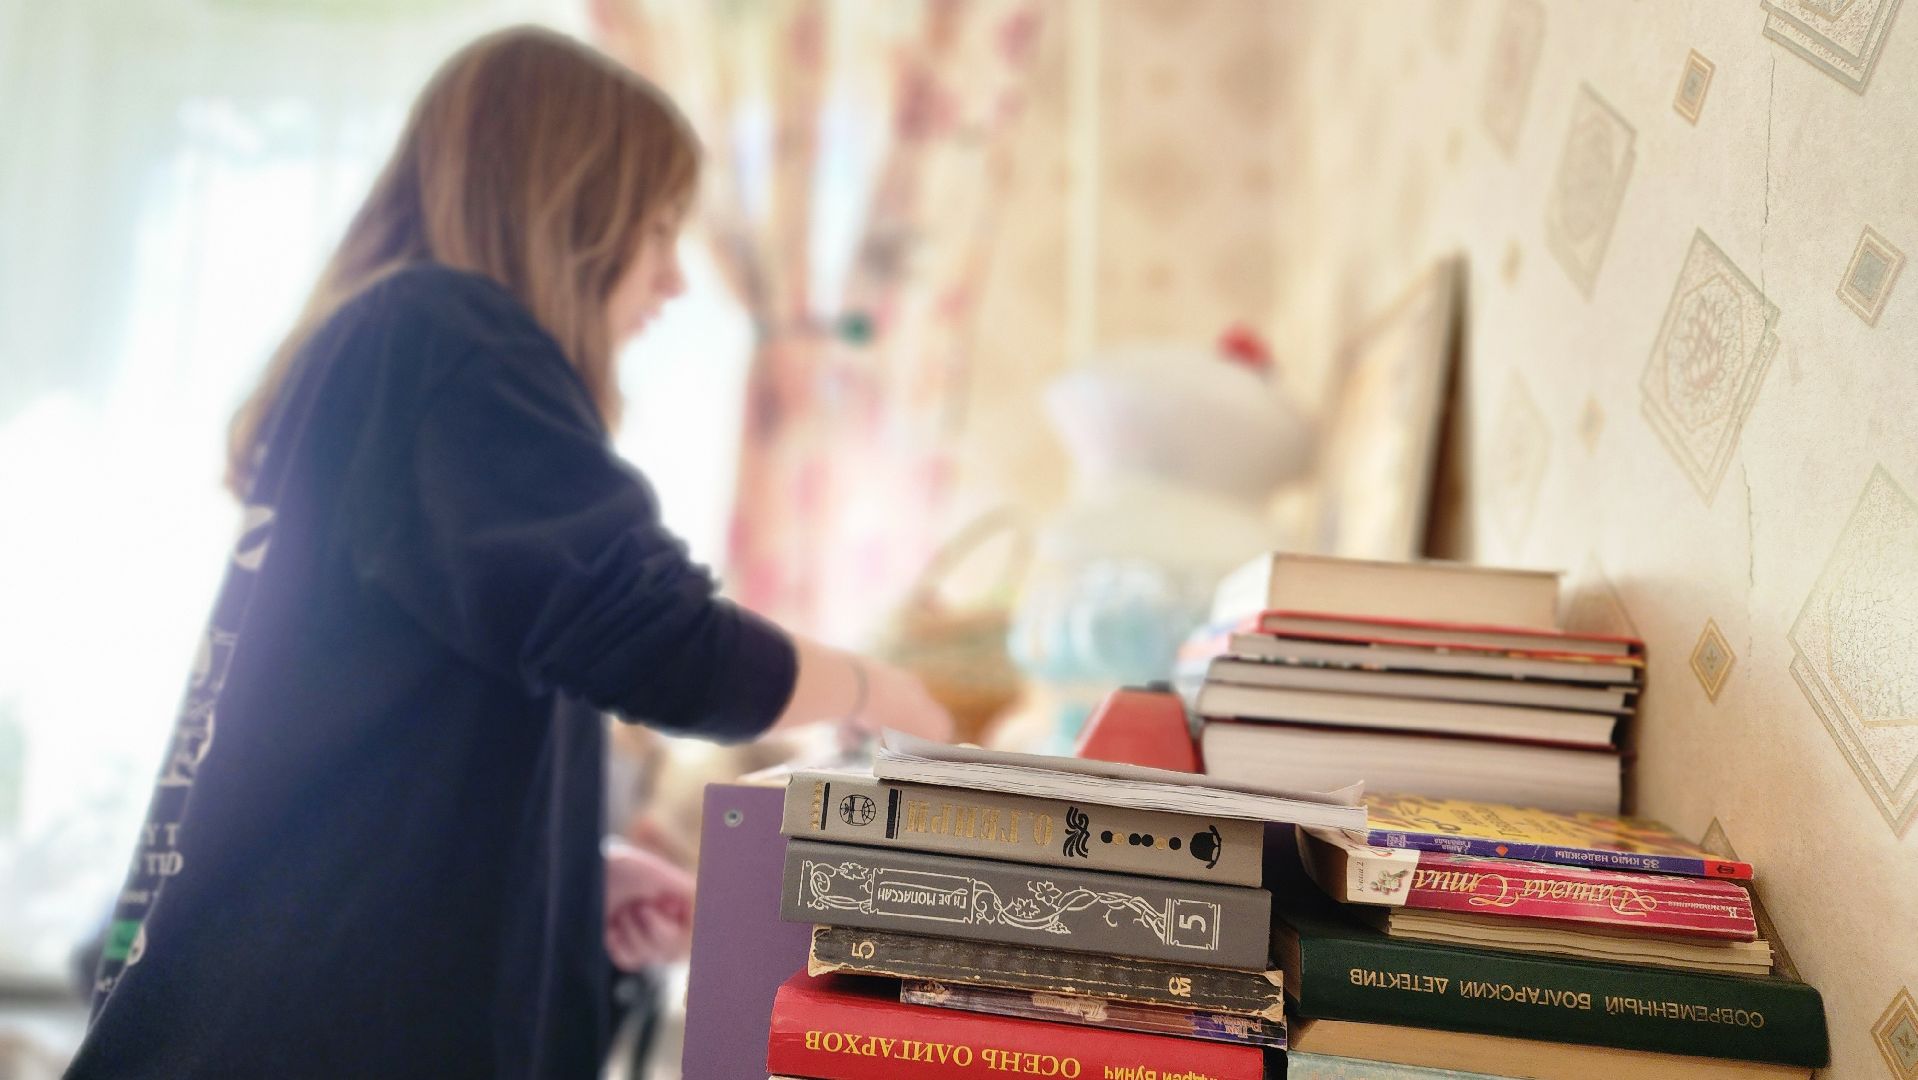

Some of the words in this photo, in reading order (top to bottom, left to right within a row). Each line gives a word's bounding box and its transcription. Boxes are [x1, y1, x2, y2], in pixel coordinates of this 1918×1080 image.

[905, 800, 1022, 844] ГЕНРИ
[1555, 850, 1609, 863] надежды
[1643, 858, 1660, 869] 35
[877, 887, 937, 906] МОПАССАН
[1520, 878, 1658, 917] Даниэла
[1178, 913, 1206, 933] 5
[852, 941, 875, 959] 5
[1350, 968, 1449, 995] ДЕТЕКТИВ
[1460, 980, 1591, 1010] БОЛГАРСКИЙ
[1604, 996, 1765, 1028] СОВРЕМЕННЫЙ
[804, 1030, 973, 1067] ОЛИГАРХОВ
[982, 1047, 1082, 1079] ОСЕНЬ
